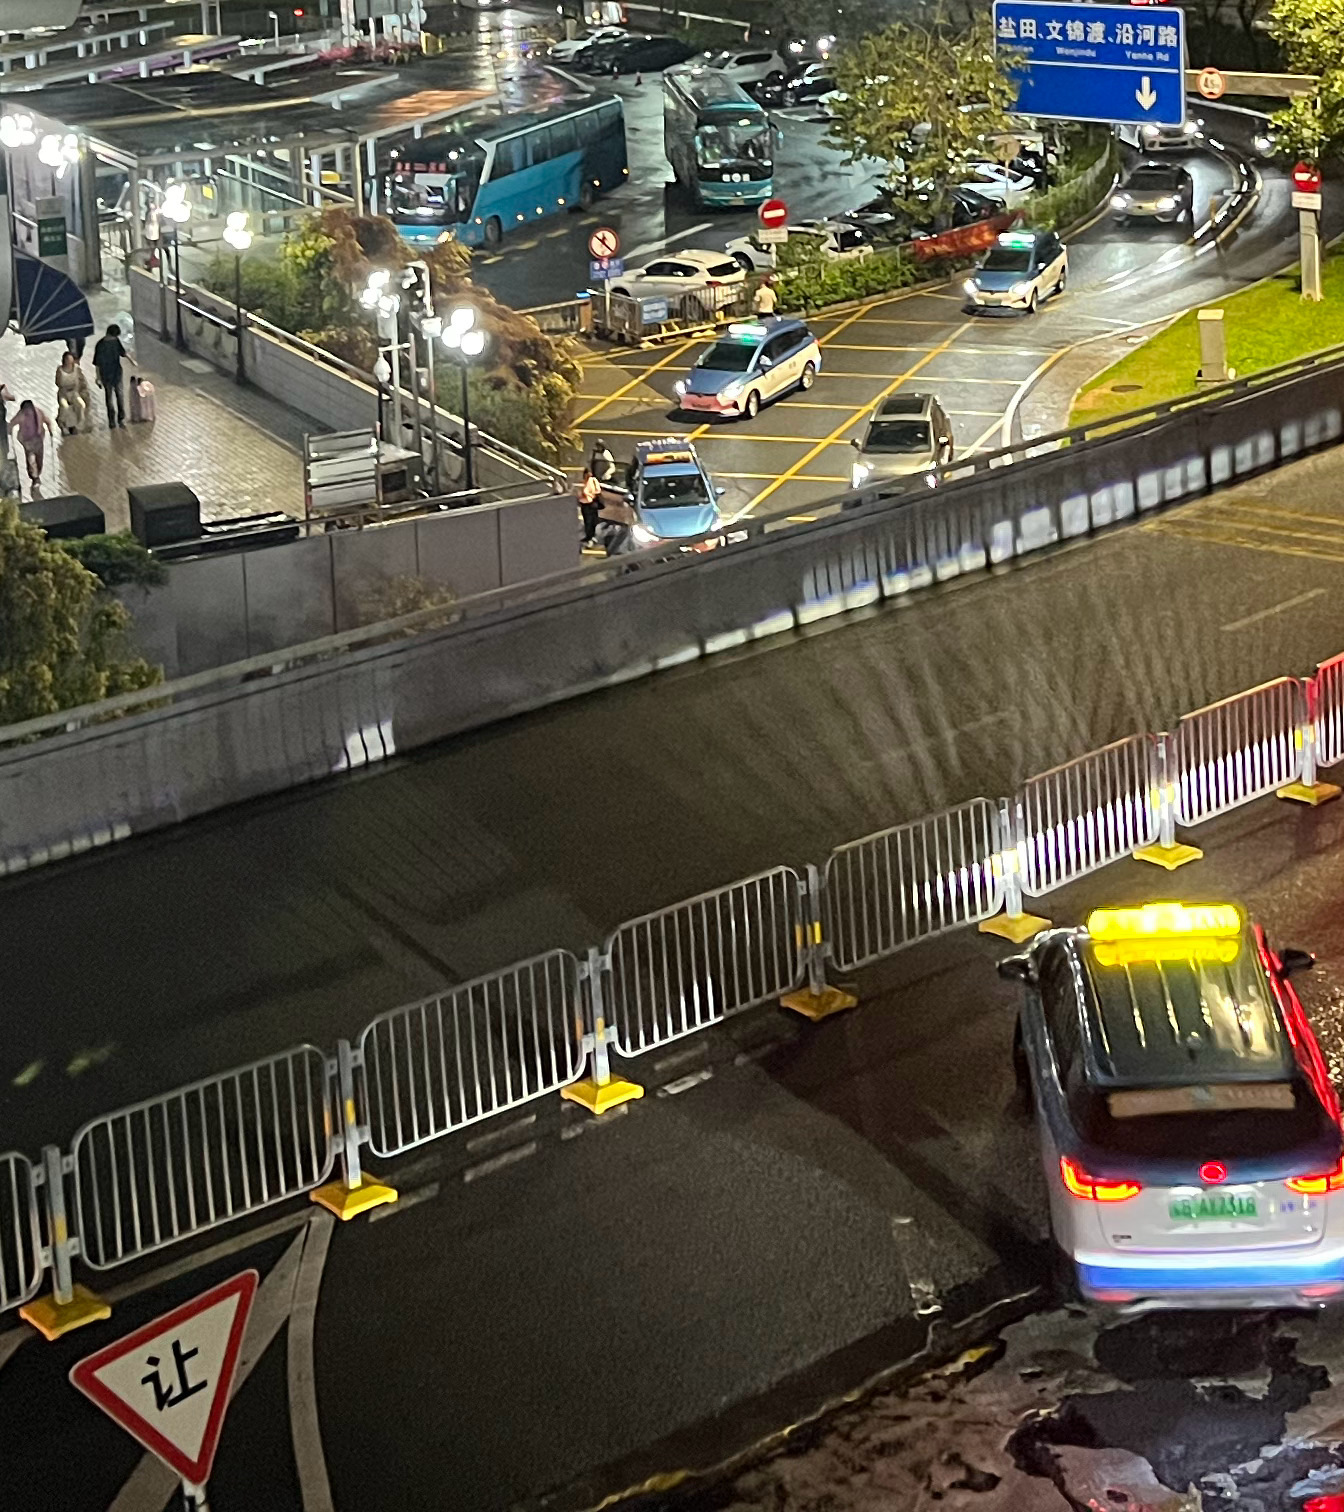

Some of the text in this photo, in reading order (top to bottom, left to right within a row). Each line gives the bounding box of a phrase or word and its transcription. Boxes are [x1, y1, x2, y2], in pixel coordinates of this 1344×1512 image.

[997, 16, 1178, 48] 盐田、文锦渡、沿河路
[141, 1339, 208, 1412] 让
